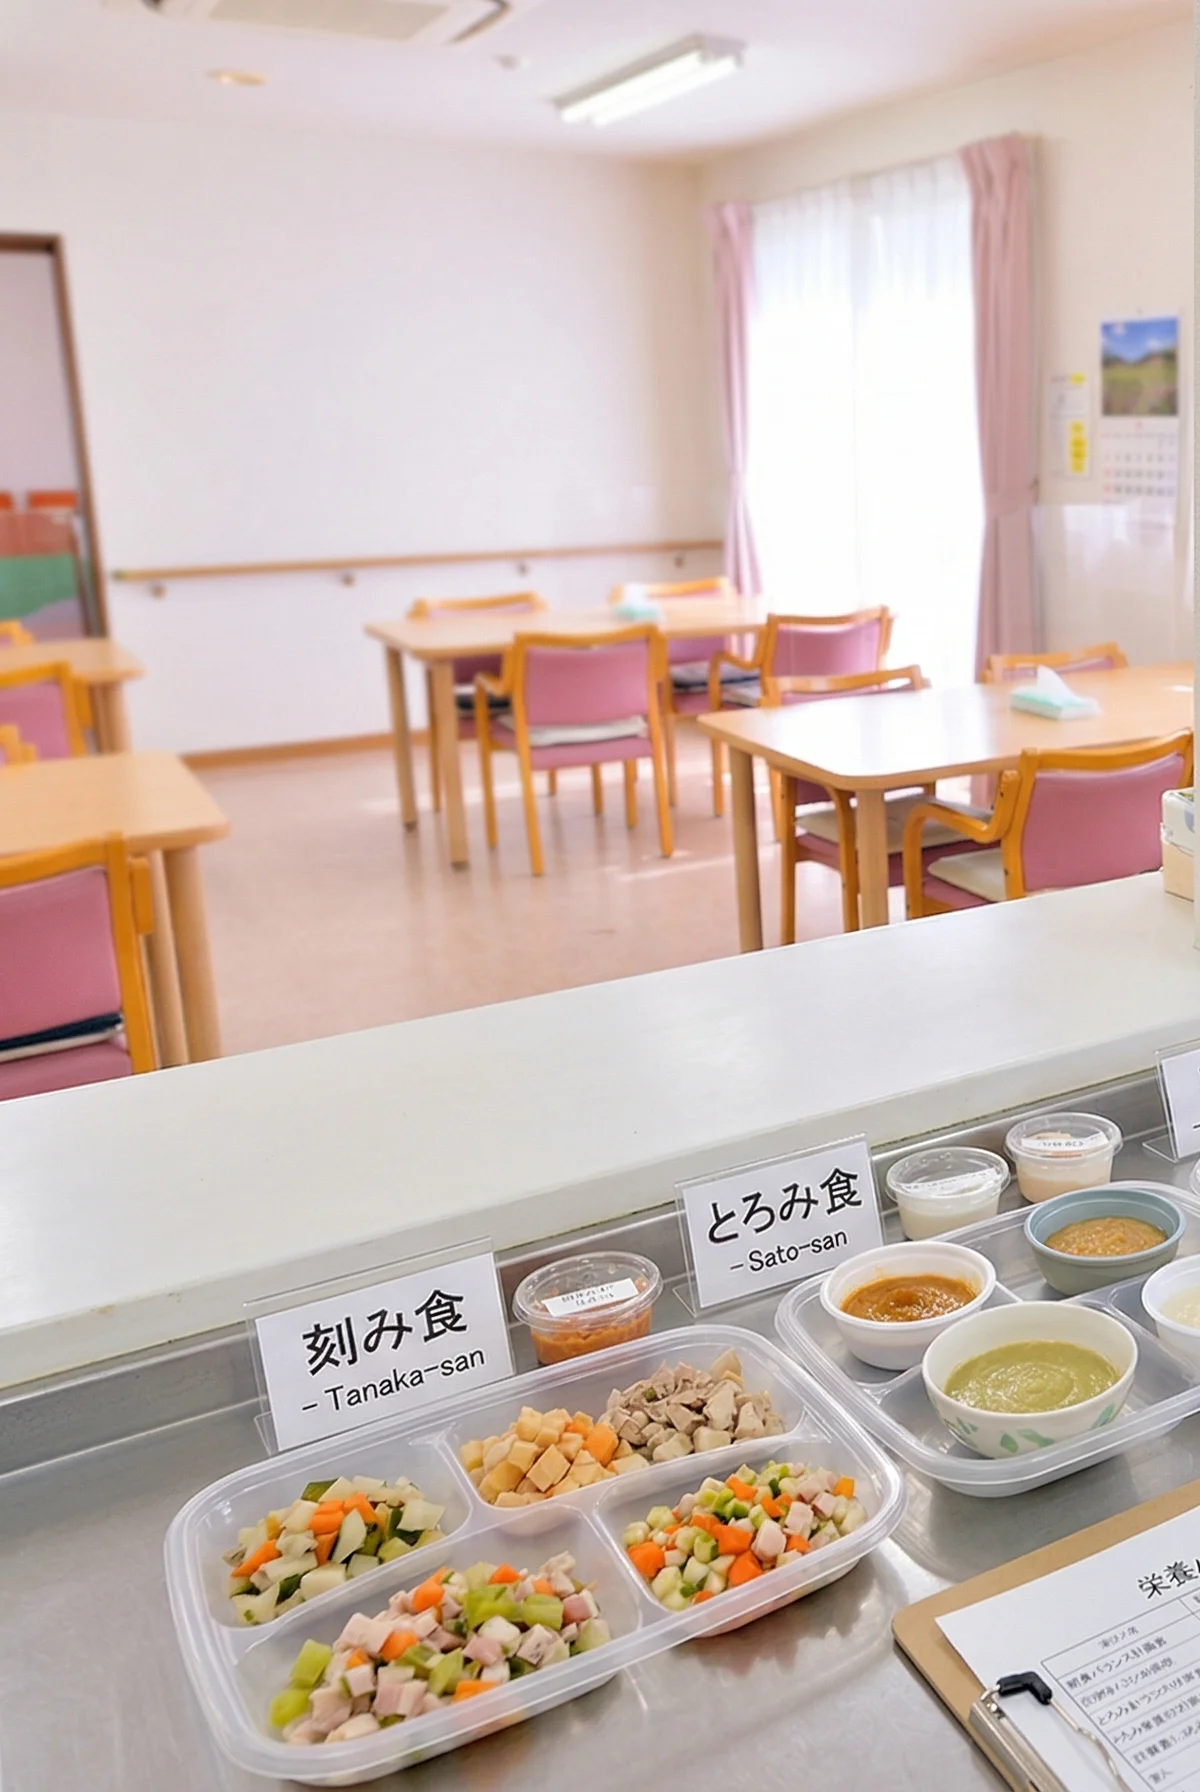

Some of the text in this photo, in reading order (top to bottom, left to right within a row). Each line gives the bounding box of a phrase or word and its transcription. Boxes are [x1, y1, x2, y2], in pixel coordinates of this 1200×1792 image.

[708, 1167, 862, 1244] とろみ食
[303, 1289, 467, 1376] 刻み食
[324, 1350, 485, 1411] Tanaka-san
